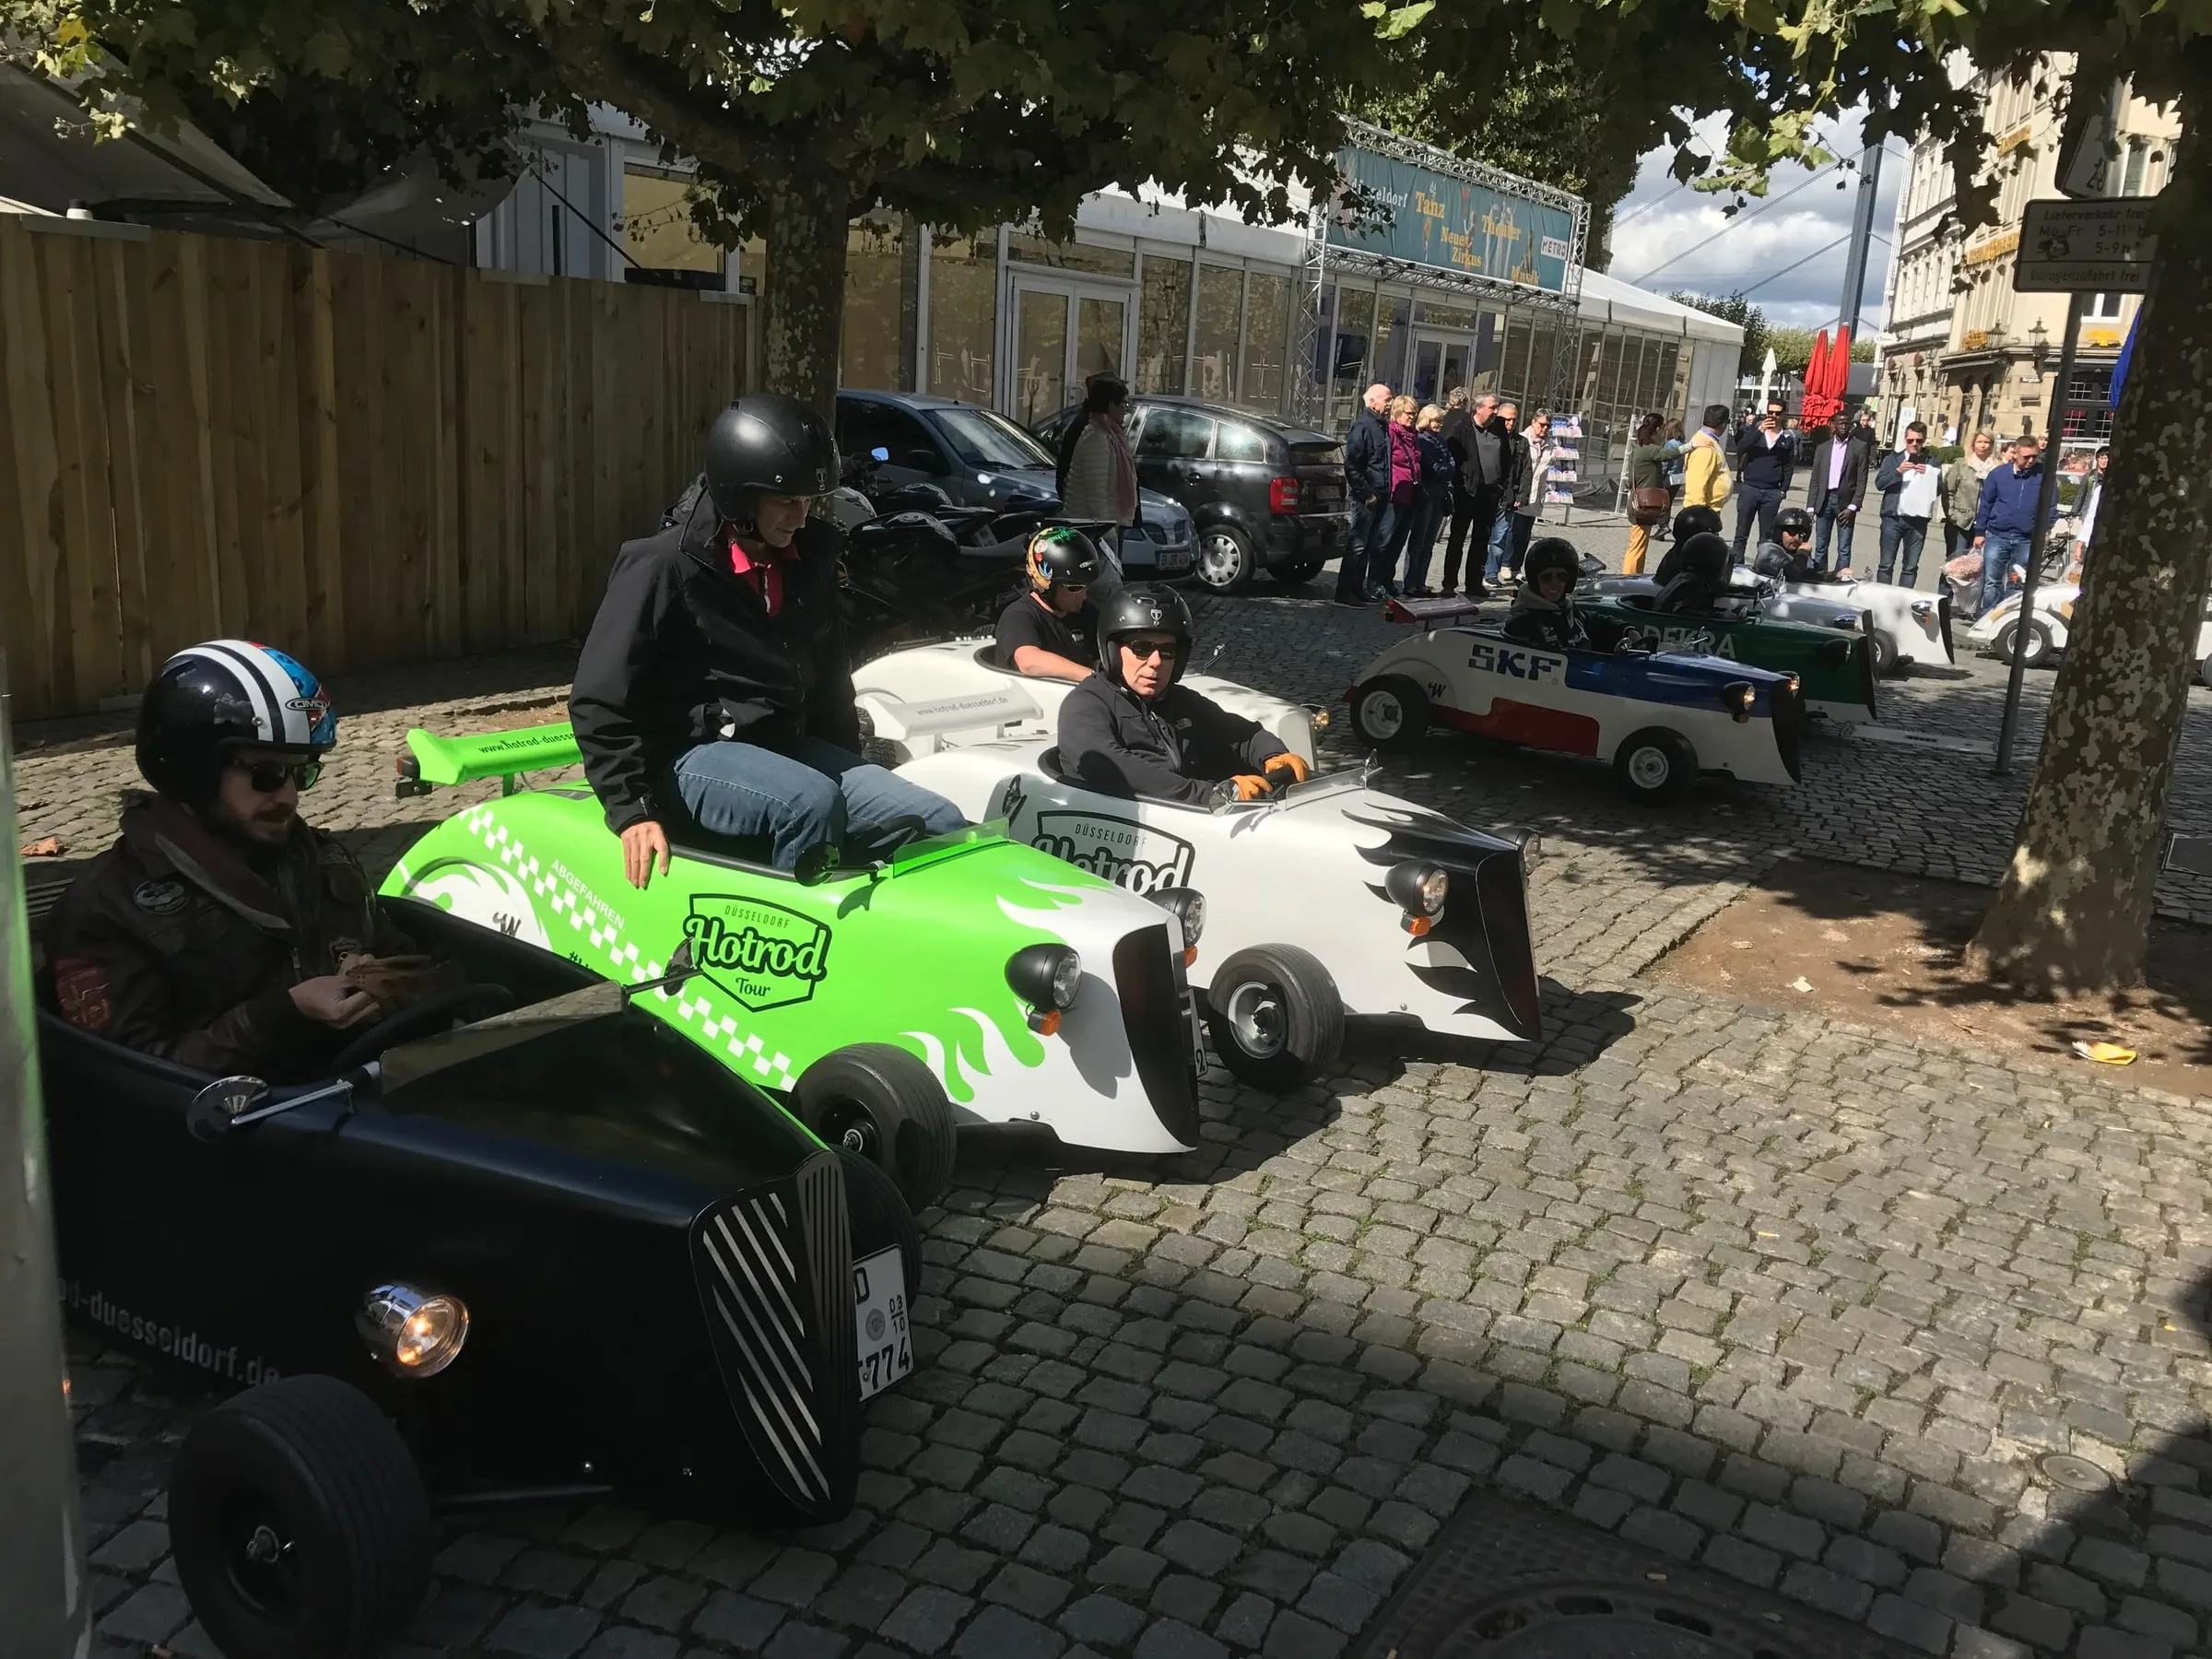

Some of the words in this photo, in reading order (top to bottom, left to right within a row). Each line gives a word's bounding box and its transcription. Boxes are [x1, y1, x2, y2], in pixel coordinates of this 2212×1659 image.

[1415, 192, 1445, 218] Tanz
[1441, 226, 1472, 248] Neuer
[1542, 240, 1566, 256] METRO
[1452, 244, 1482, 267] Zirkus
[1642, 625, 1736, 659] DEKRA
[1468, 643, 1562, 681] SKF
[1075, 823, 1147, 847] DÜSSELDORF
[725, 905, 790, 929] DÜSSELDORF
[684, 915, 830, 980] Hotrod
[735, 977, 771, 997] Tour
[889, 1294, 903, 1313] 03
[892, 1316, 906, 1335] 10
